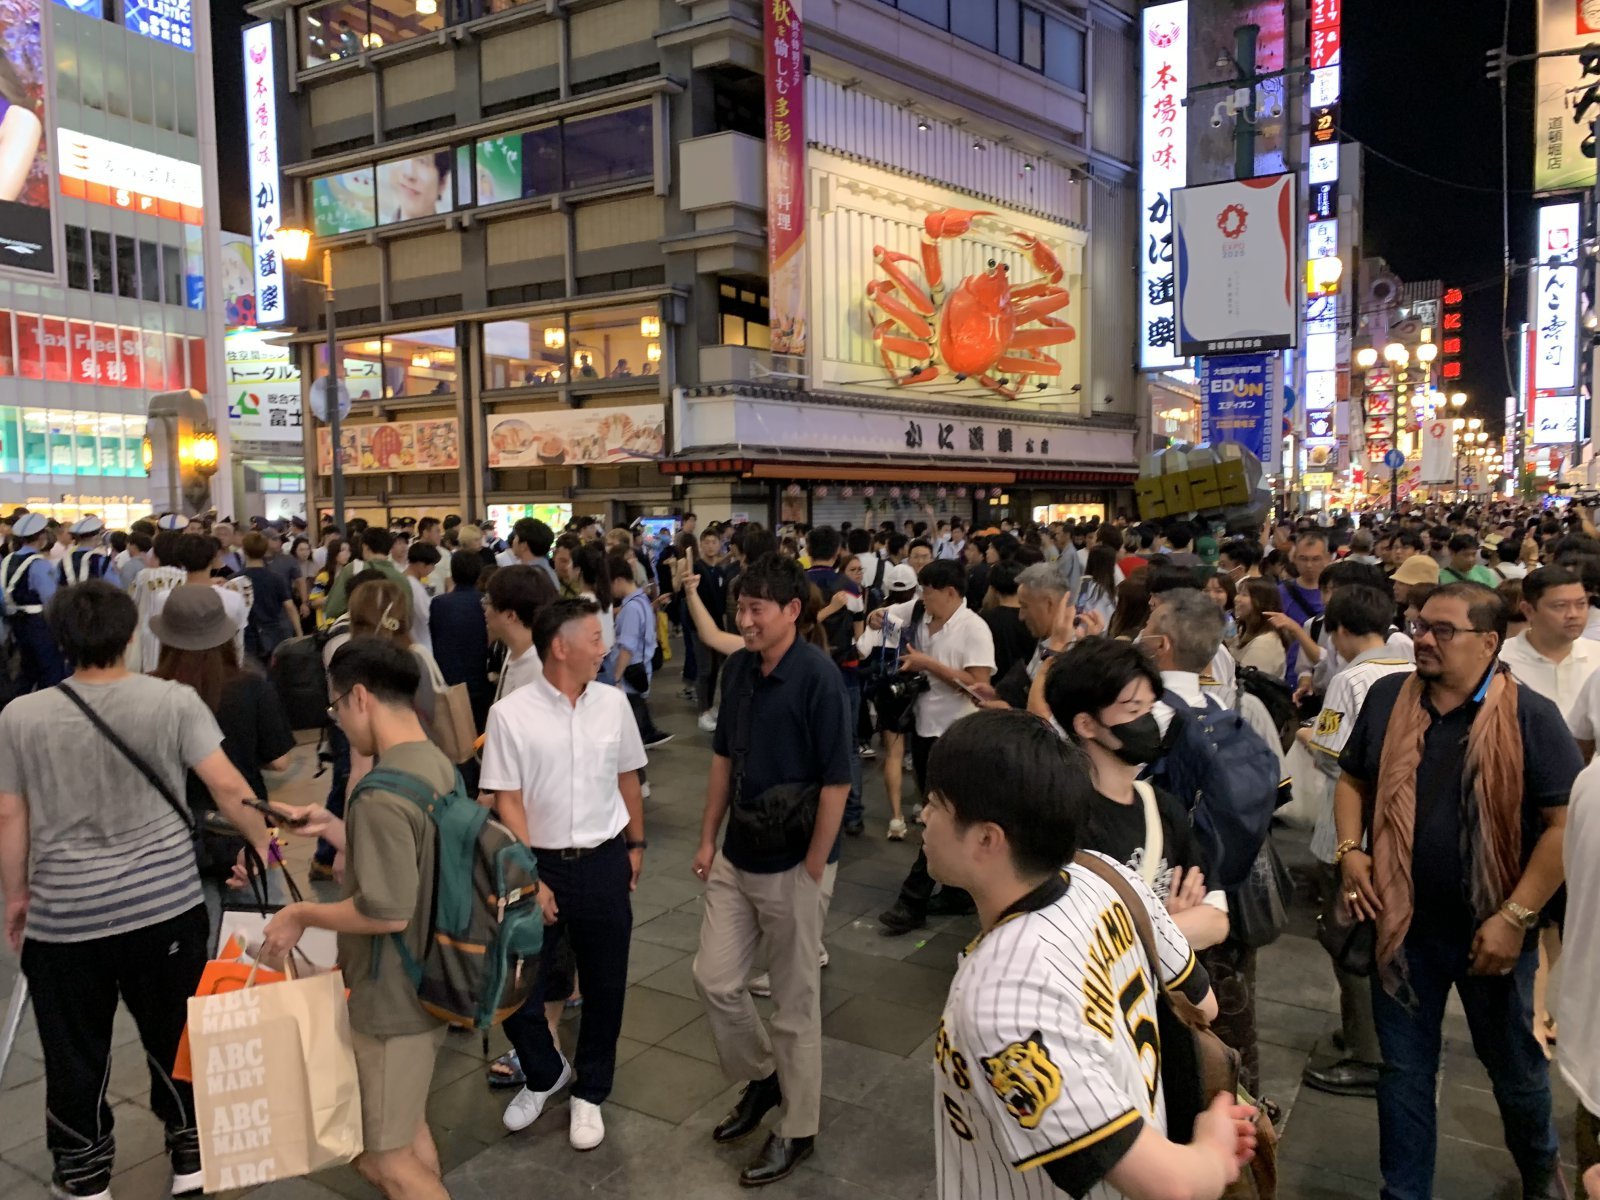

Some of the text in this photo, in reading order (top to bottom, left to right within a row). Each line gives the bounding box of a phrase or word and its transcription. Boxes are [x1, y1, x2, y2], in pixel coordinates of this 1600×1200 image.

[254, 75, 270, 166] 本場の味
[1151, 61, 1177, 170] 本場の味
[1222, 242, 1245, 251] EXPO
[1222, 250, 1245, 258] 2025
[32, 328, 68, 347] Tax
[75, 333, 116, 353] Free
[81, 357, 128, 382] 免税
[231, 366, 301, 382] トータル
[1211, 378, 1263, 397] EDION
[1217, 401, 1256, 409] エディオン
[202, 987, 260, 1015] ABC
[202, 1006, 260, 1035] MART
[206, 1038, 264, 1075] ABC
[1117, 966, 1160, 1119] 5
[206, 1066, 265, 1095] MART
[212, 1097, 270, 1135] ABC
[212, 1126, 271, 1156] MART
[219, 1158, 276, 1190] ABC
